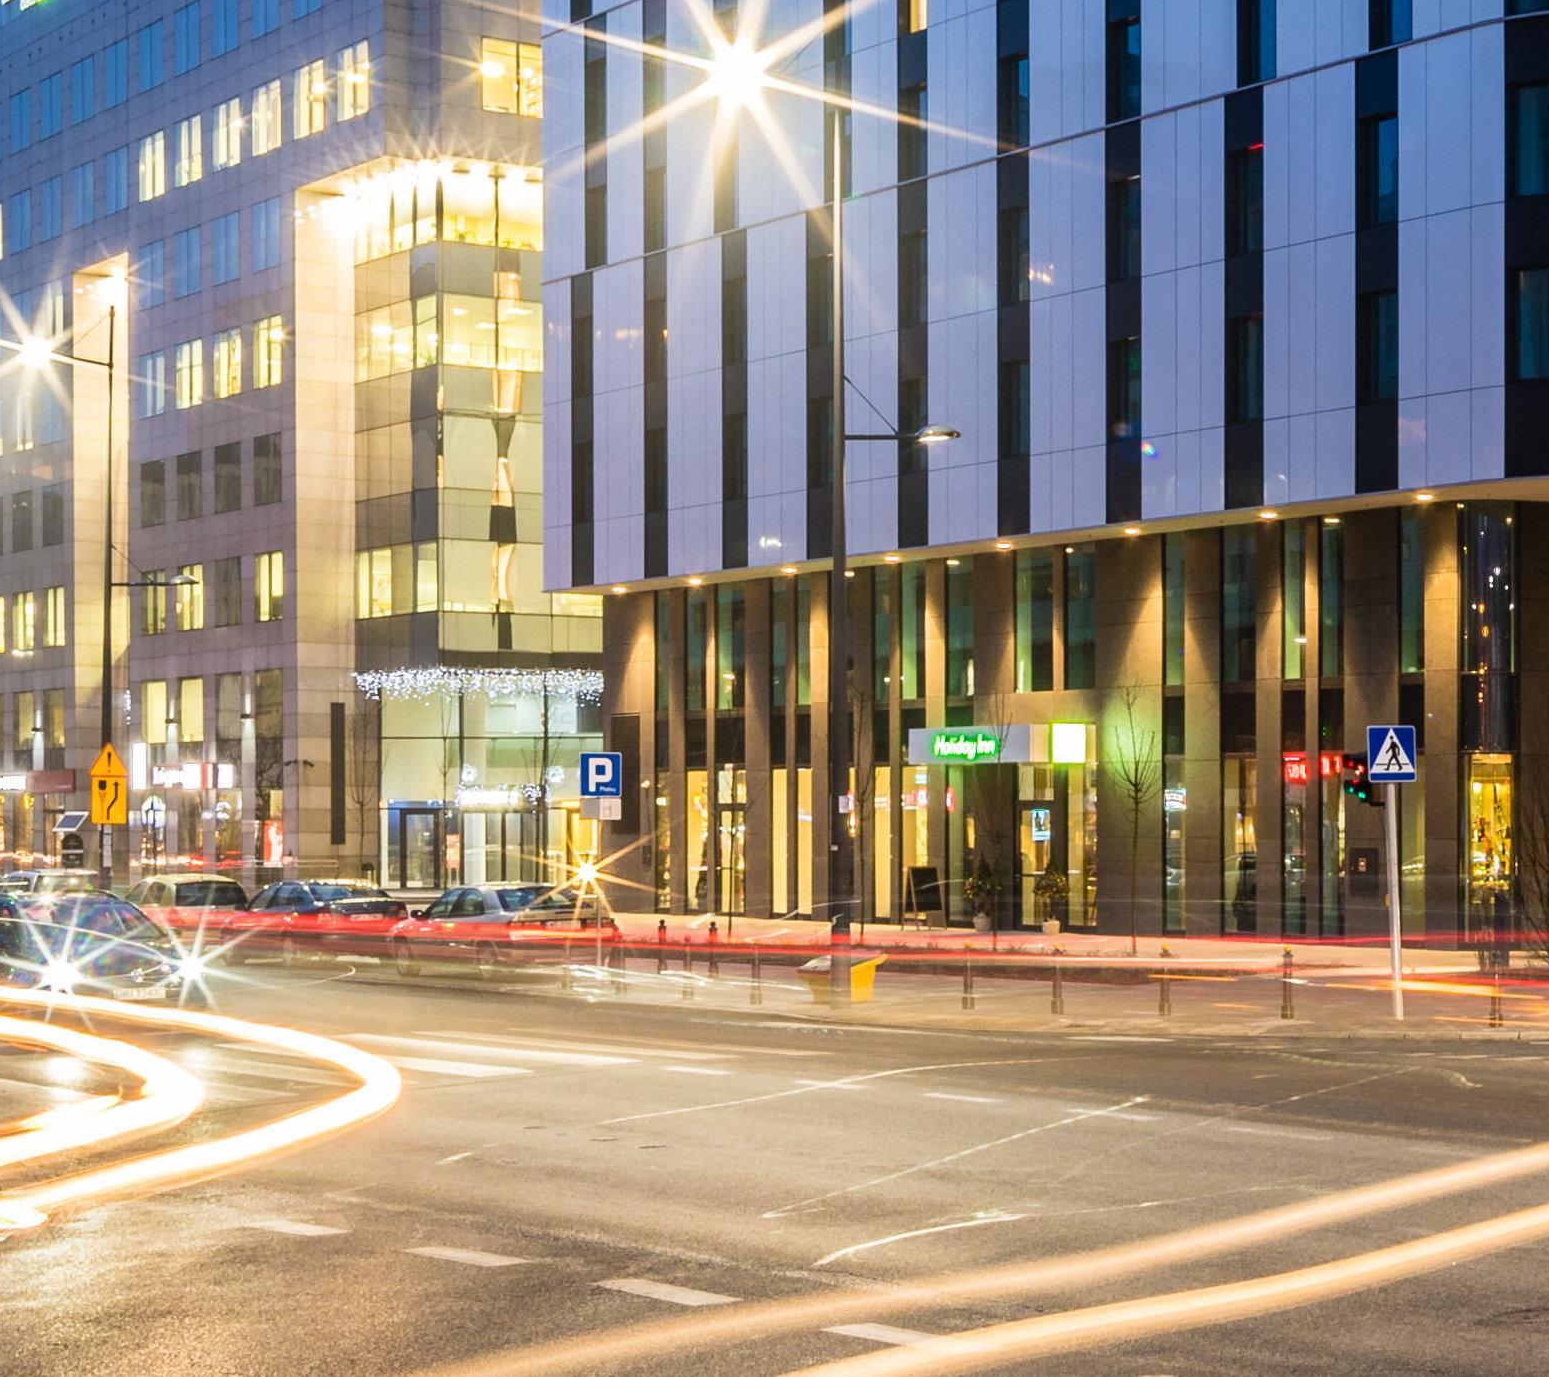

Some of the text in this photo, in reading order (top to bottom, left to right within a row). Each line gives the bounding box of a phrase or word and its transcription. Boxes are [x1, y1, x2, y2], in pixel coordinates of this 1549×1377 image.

[933, 733, 996, 760] Holiday Inn
[588, 757, 613, 792] P
